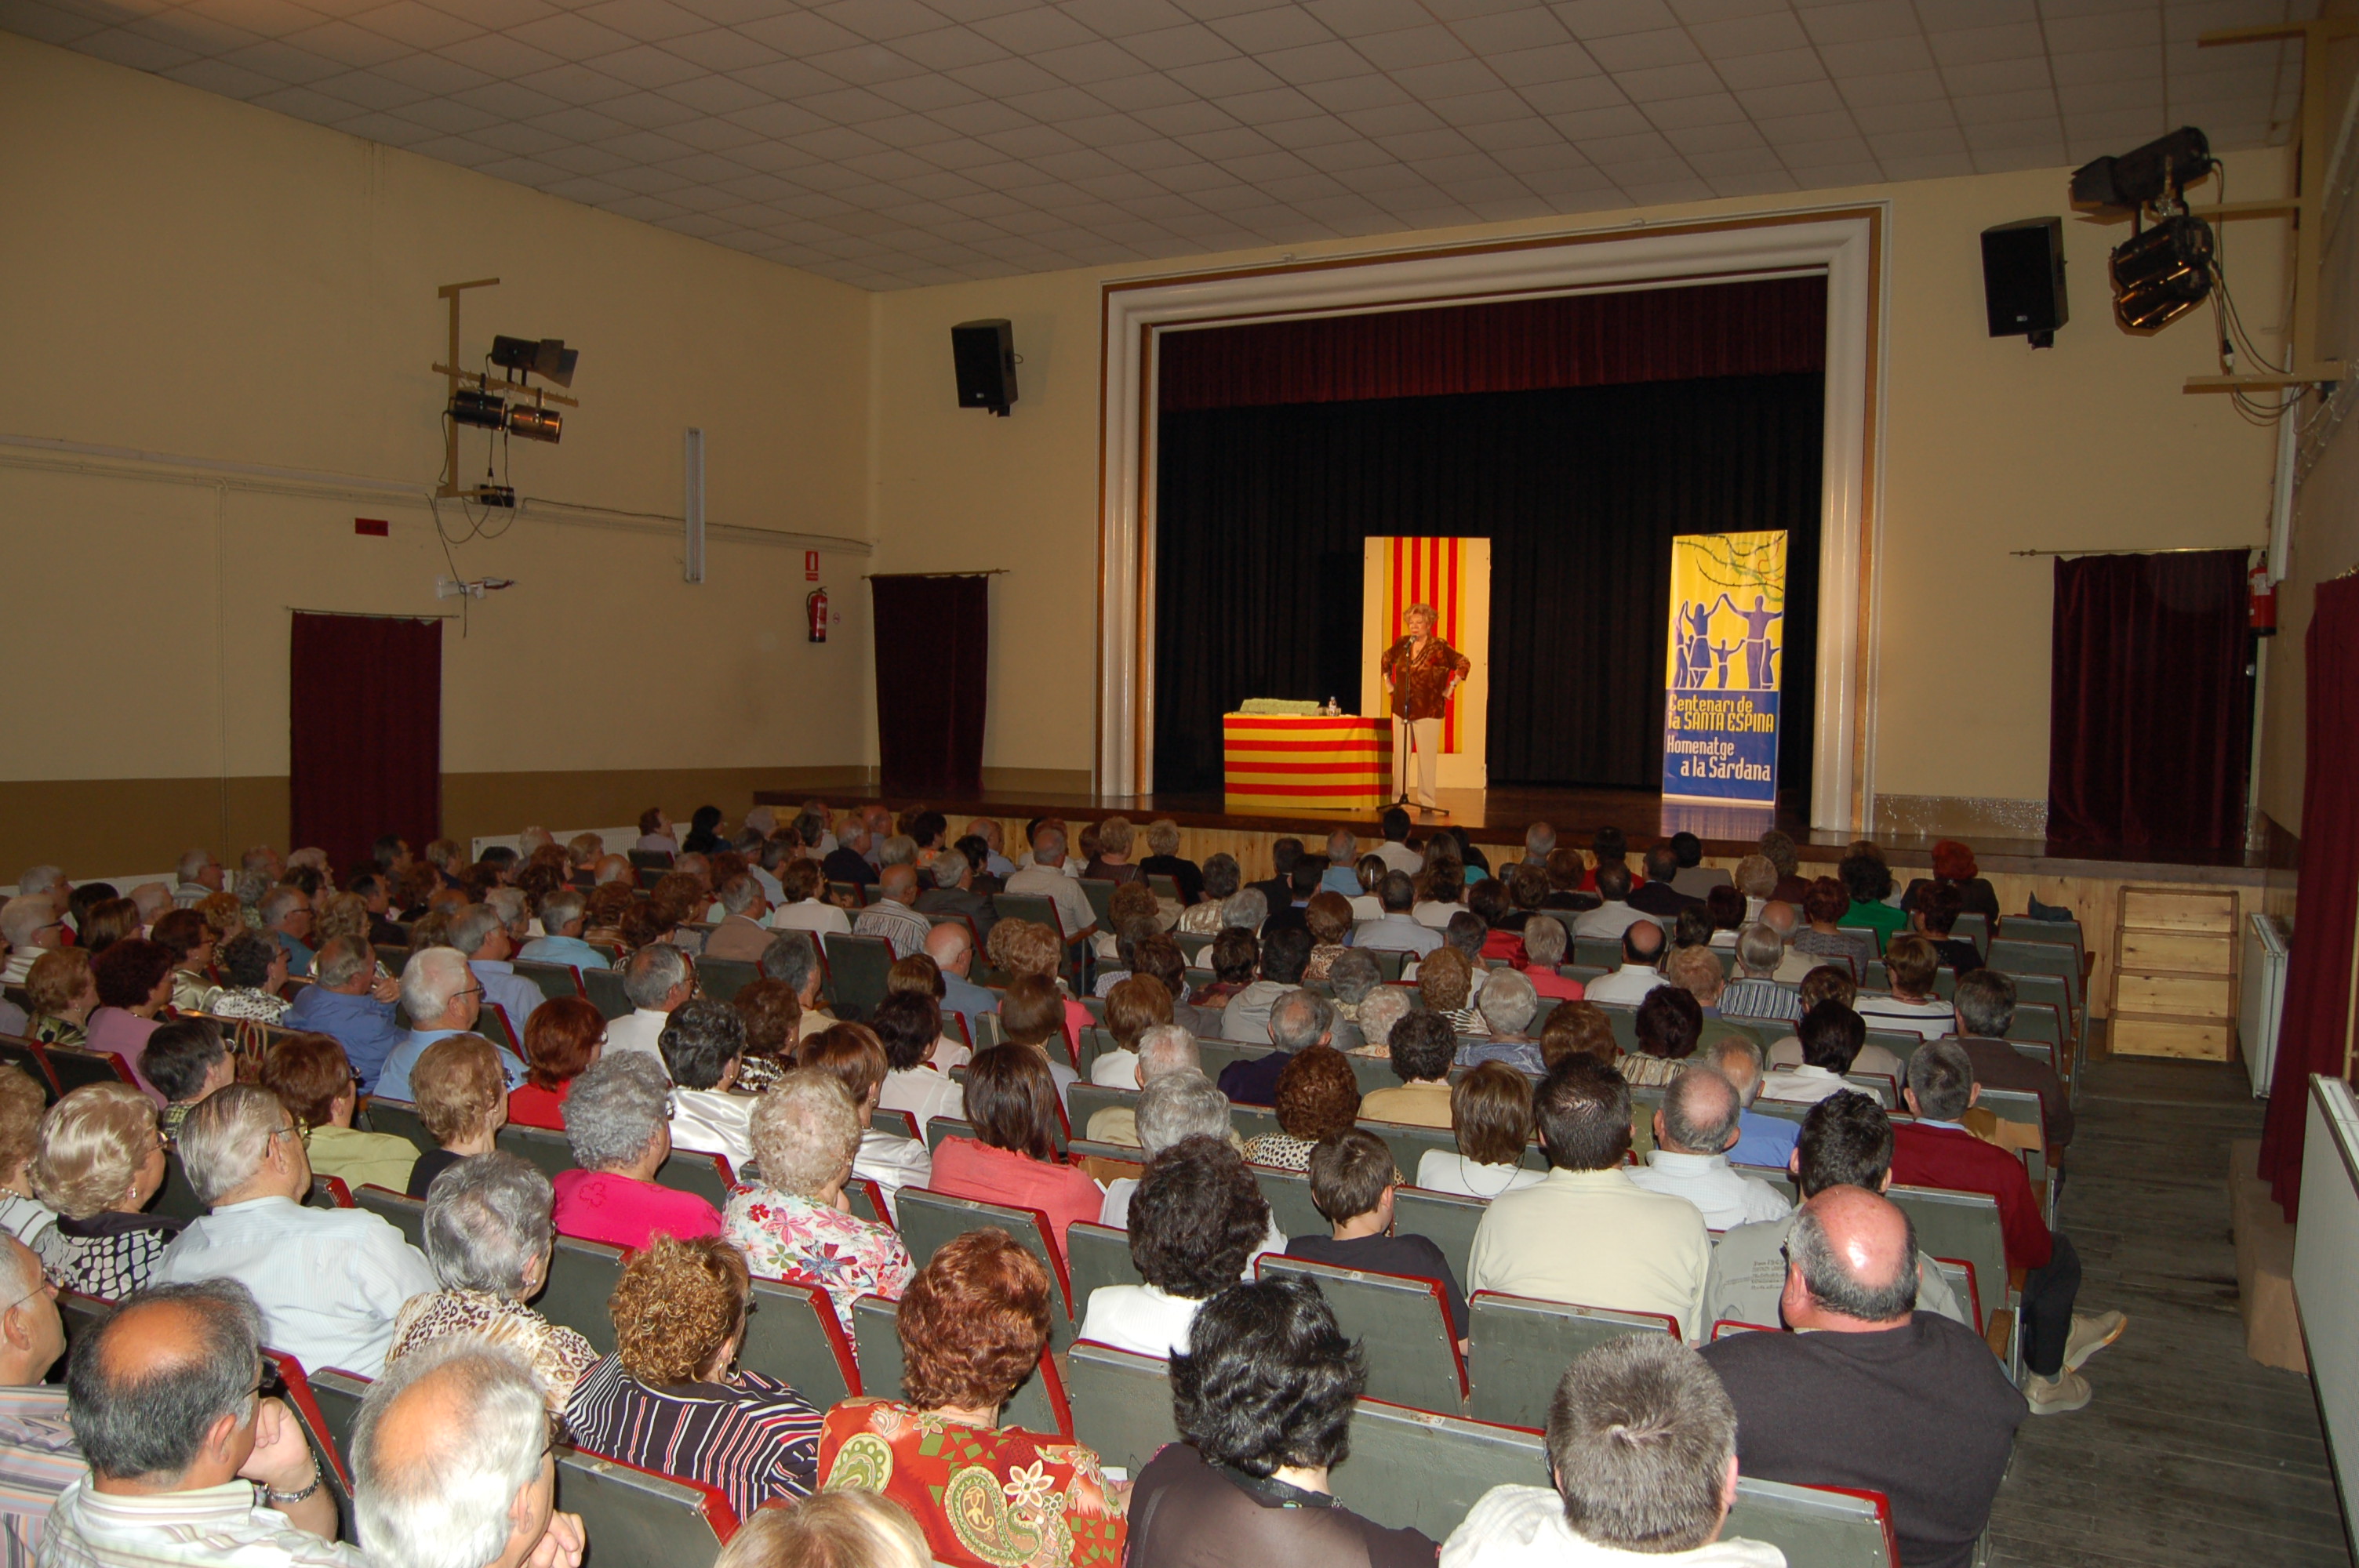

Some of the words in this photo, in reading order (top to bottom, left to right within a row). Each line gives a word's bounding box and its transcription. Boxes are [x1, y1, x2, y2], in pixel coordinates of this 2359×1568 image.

[1669, 694, 1734, 713] Centenari
[1736, 695, 1753, 713] de
[1668, 711, 1681, 730] la
[1683, 711, 1725, 731] SANTA
[1728, 712, 1775, 733] ESPINA
[1667, 735, 1735, 760] Homenatge
[1680, 760, 1690, 777] a
[1692, 755, 1706, 778] la
[1708, 756, 1772, 782] Sardana
